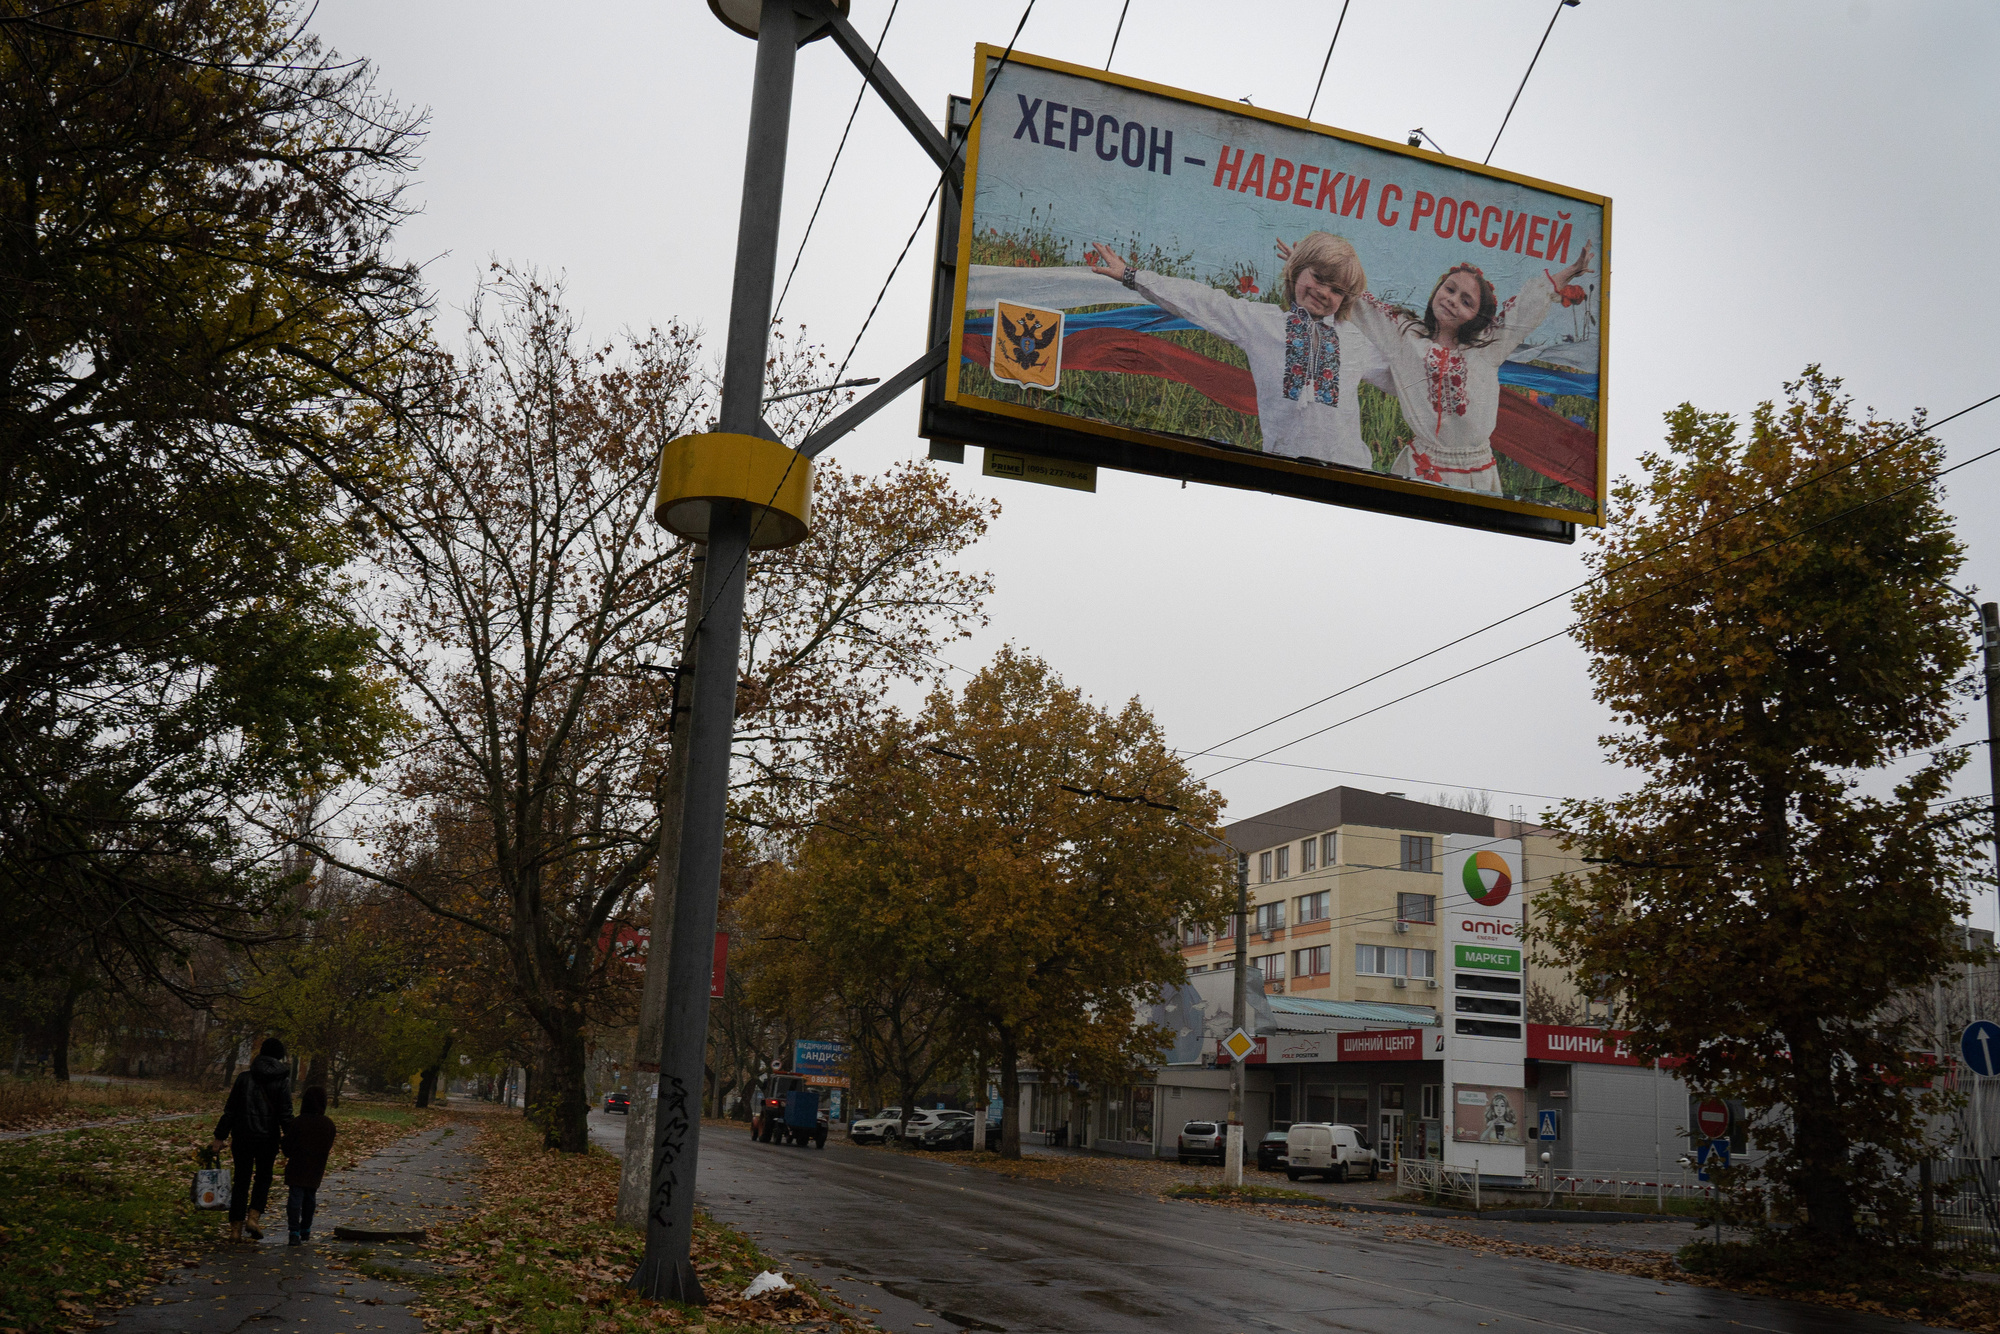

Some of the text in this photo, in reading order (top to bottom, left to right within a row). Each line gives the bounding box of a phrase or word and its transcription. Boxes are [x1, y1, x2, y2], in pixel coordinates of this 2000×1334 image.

[1013, 93, 1173, 176] ХЕРСОН
[1213, 145, 1371, 220] НАВЕКИ
[1377, 184, 1403, 227] С
[1409, 191, 1573, 264] РОССИЕЙ
[991, 463, 1021, 473] PRIME
[1027, 465, 1048, 476] (095)
[1462, 920, 1514, 935] amic
[1465, 952, 1512, 965] МАРКЕТ
[1343, 1034, 1415, 1053] ШИННИЙ ЦЕНТР
[1548, 1034, 1604, 1053] ШИНИ
